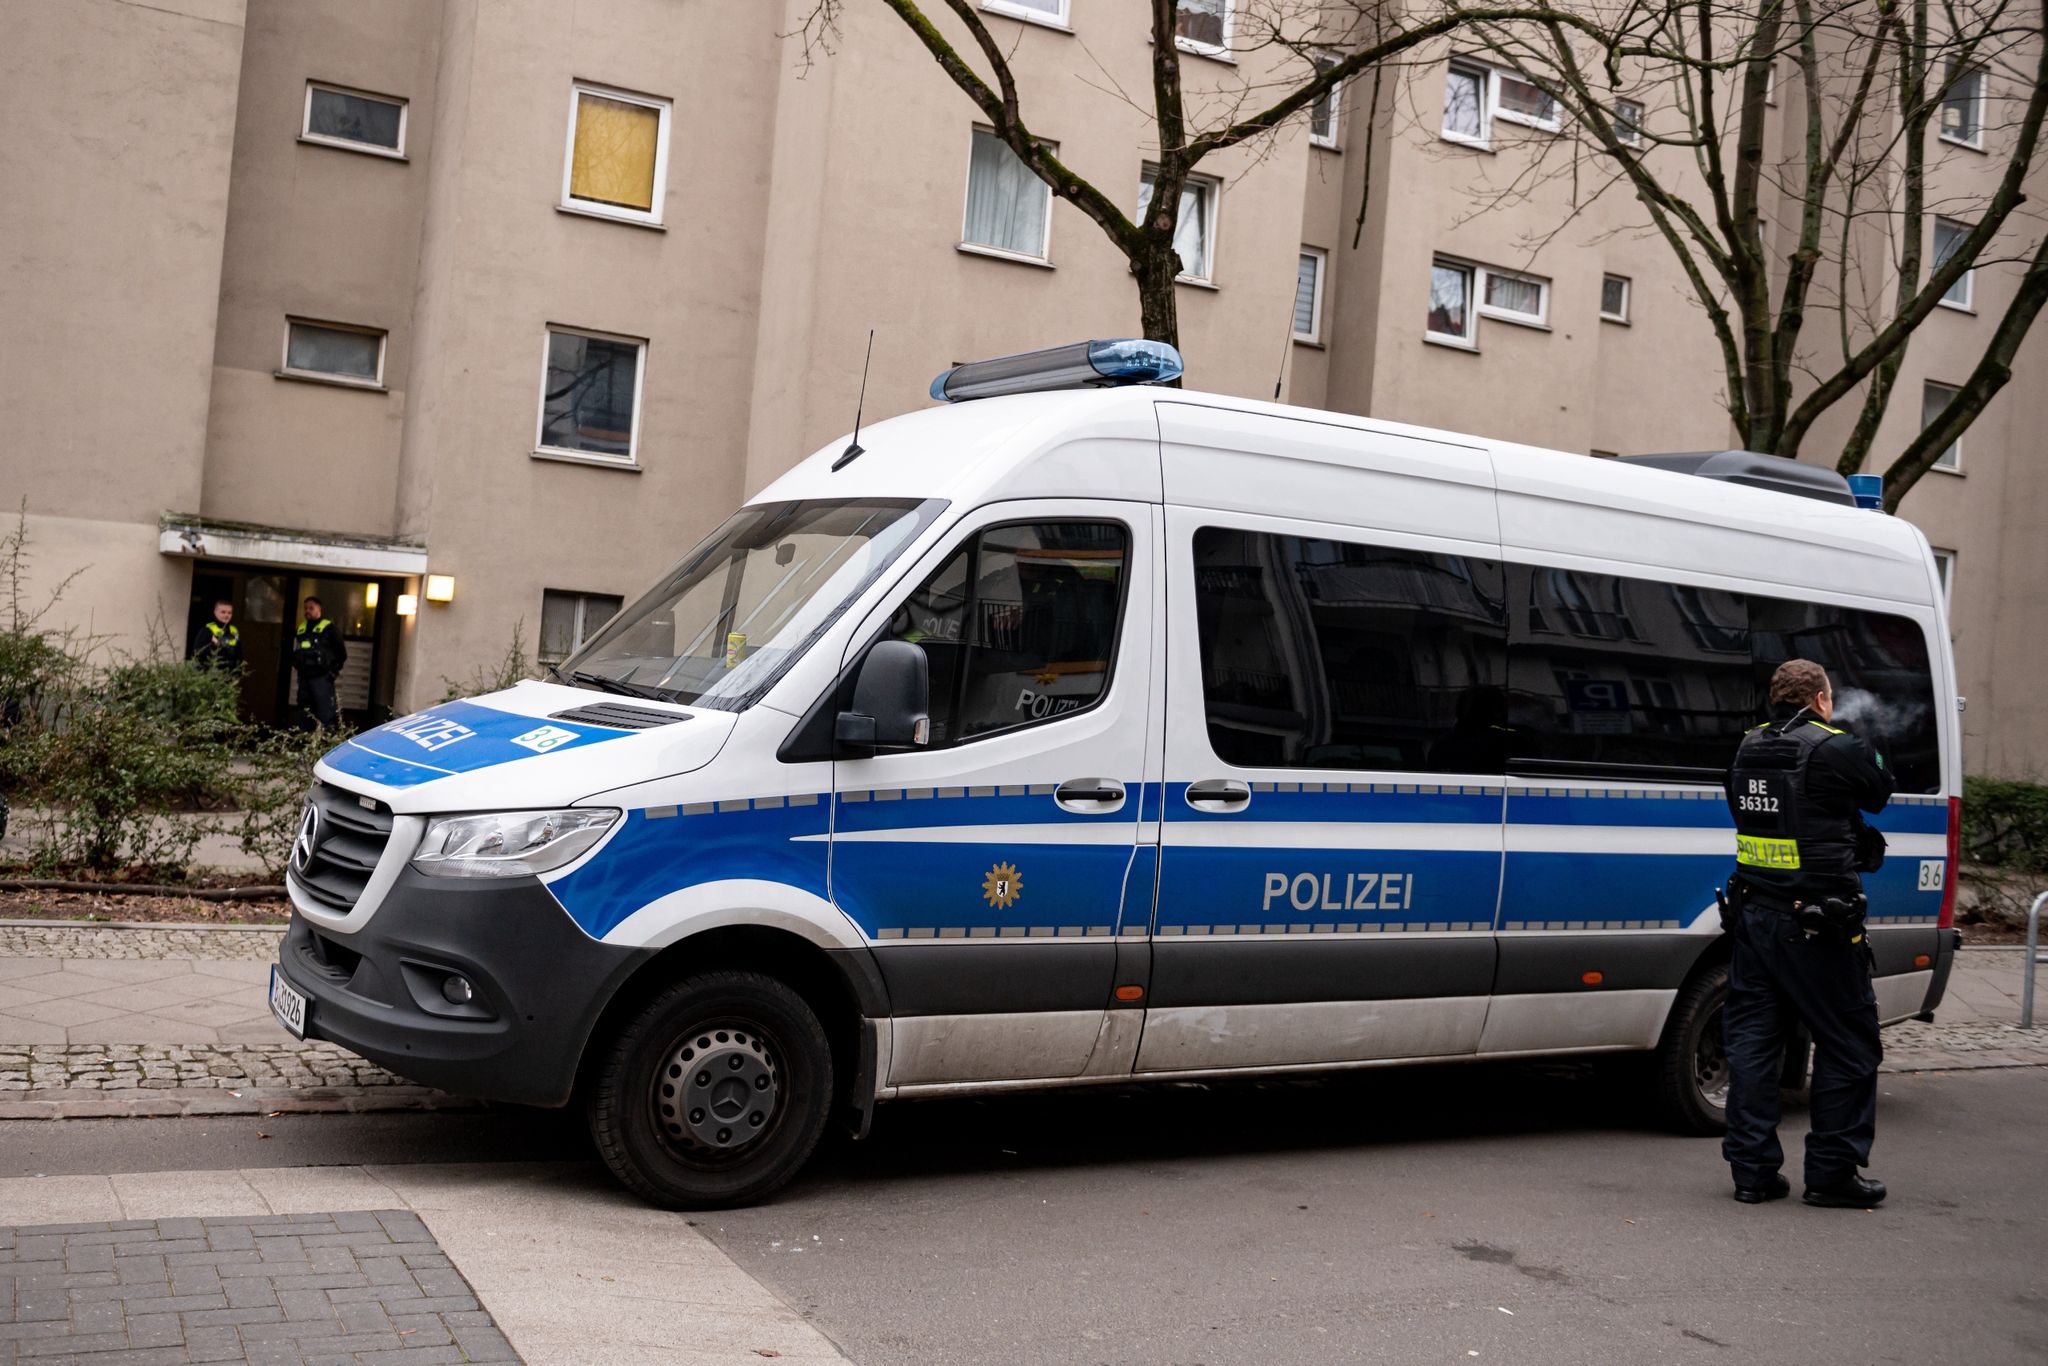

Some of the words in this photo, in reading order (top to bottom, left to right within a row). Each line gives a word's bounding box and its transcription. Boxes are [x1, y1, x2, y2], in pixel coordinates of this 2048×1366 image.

[520, 728, 569, 748] 36
[1748, 779, 1767, 794] BE
[1739, 796, 1779, 812] 36312
[1737, 839, 1796, 864] POLIZEI
[1920, 864, 1941, 887] 36
[1263, 872, 1413, 911] POLIZEI
